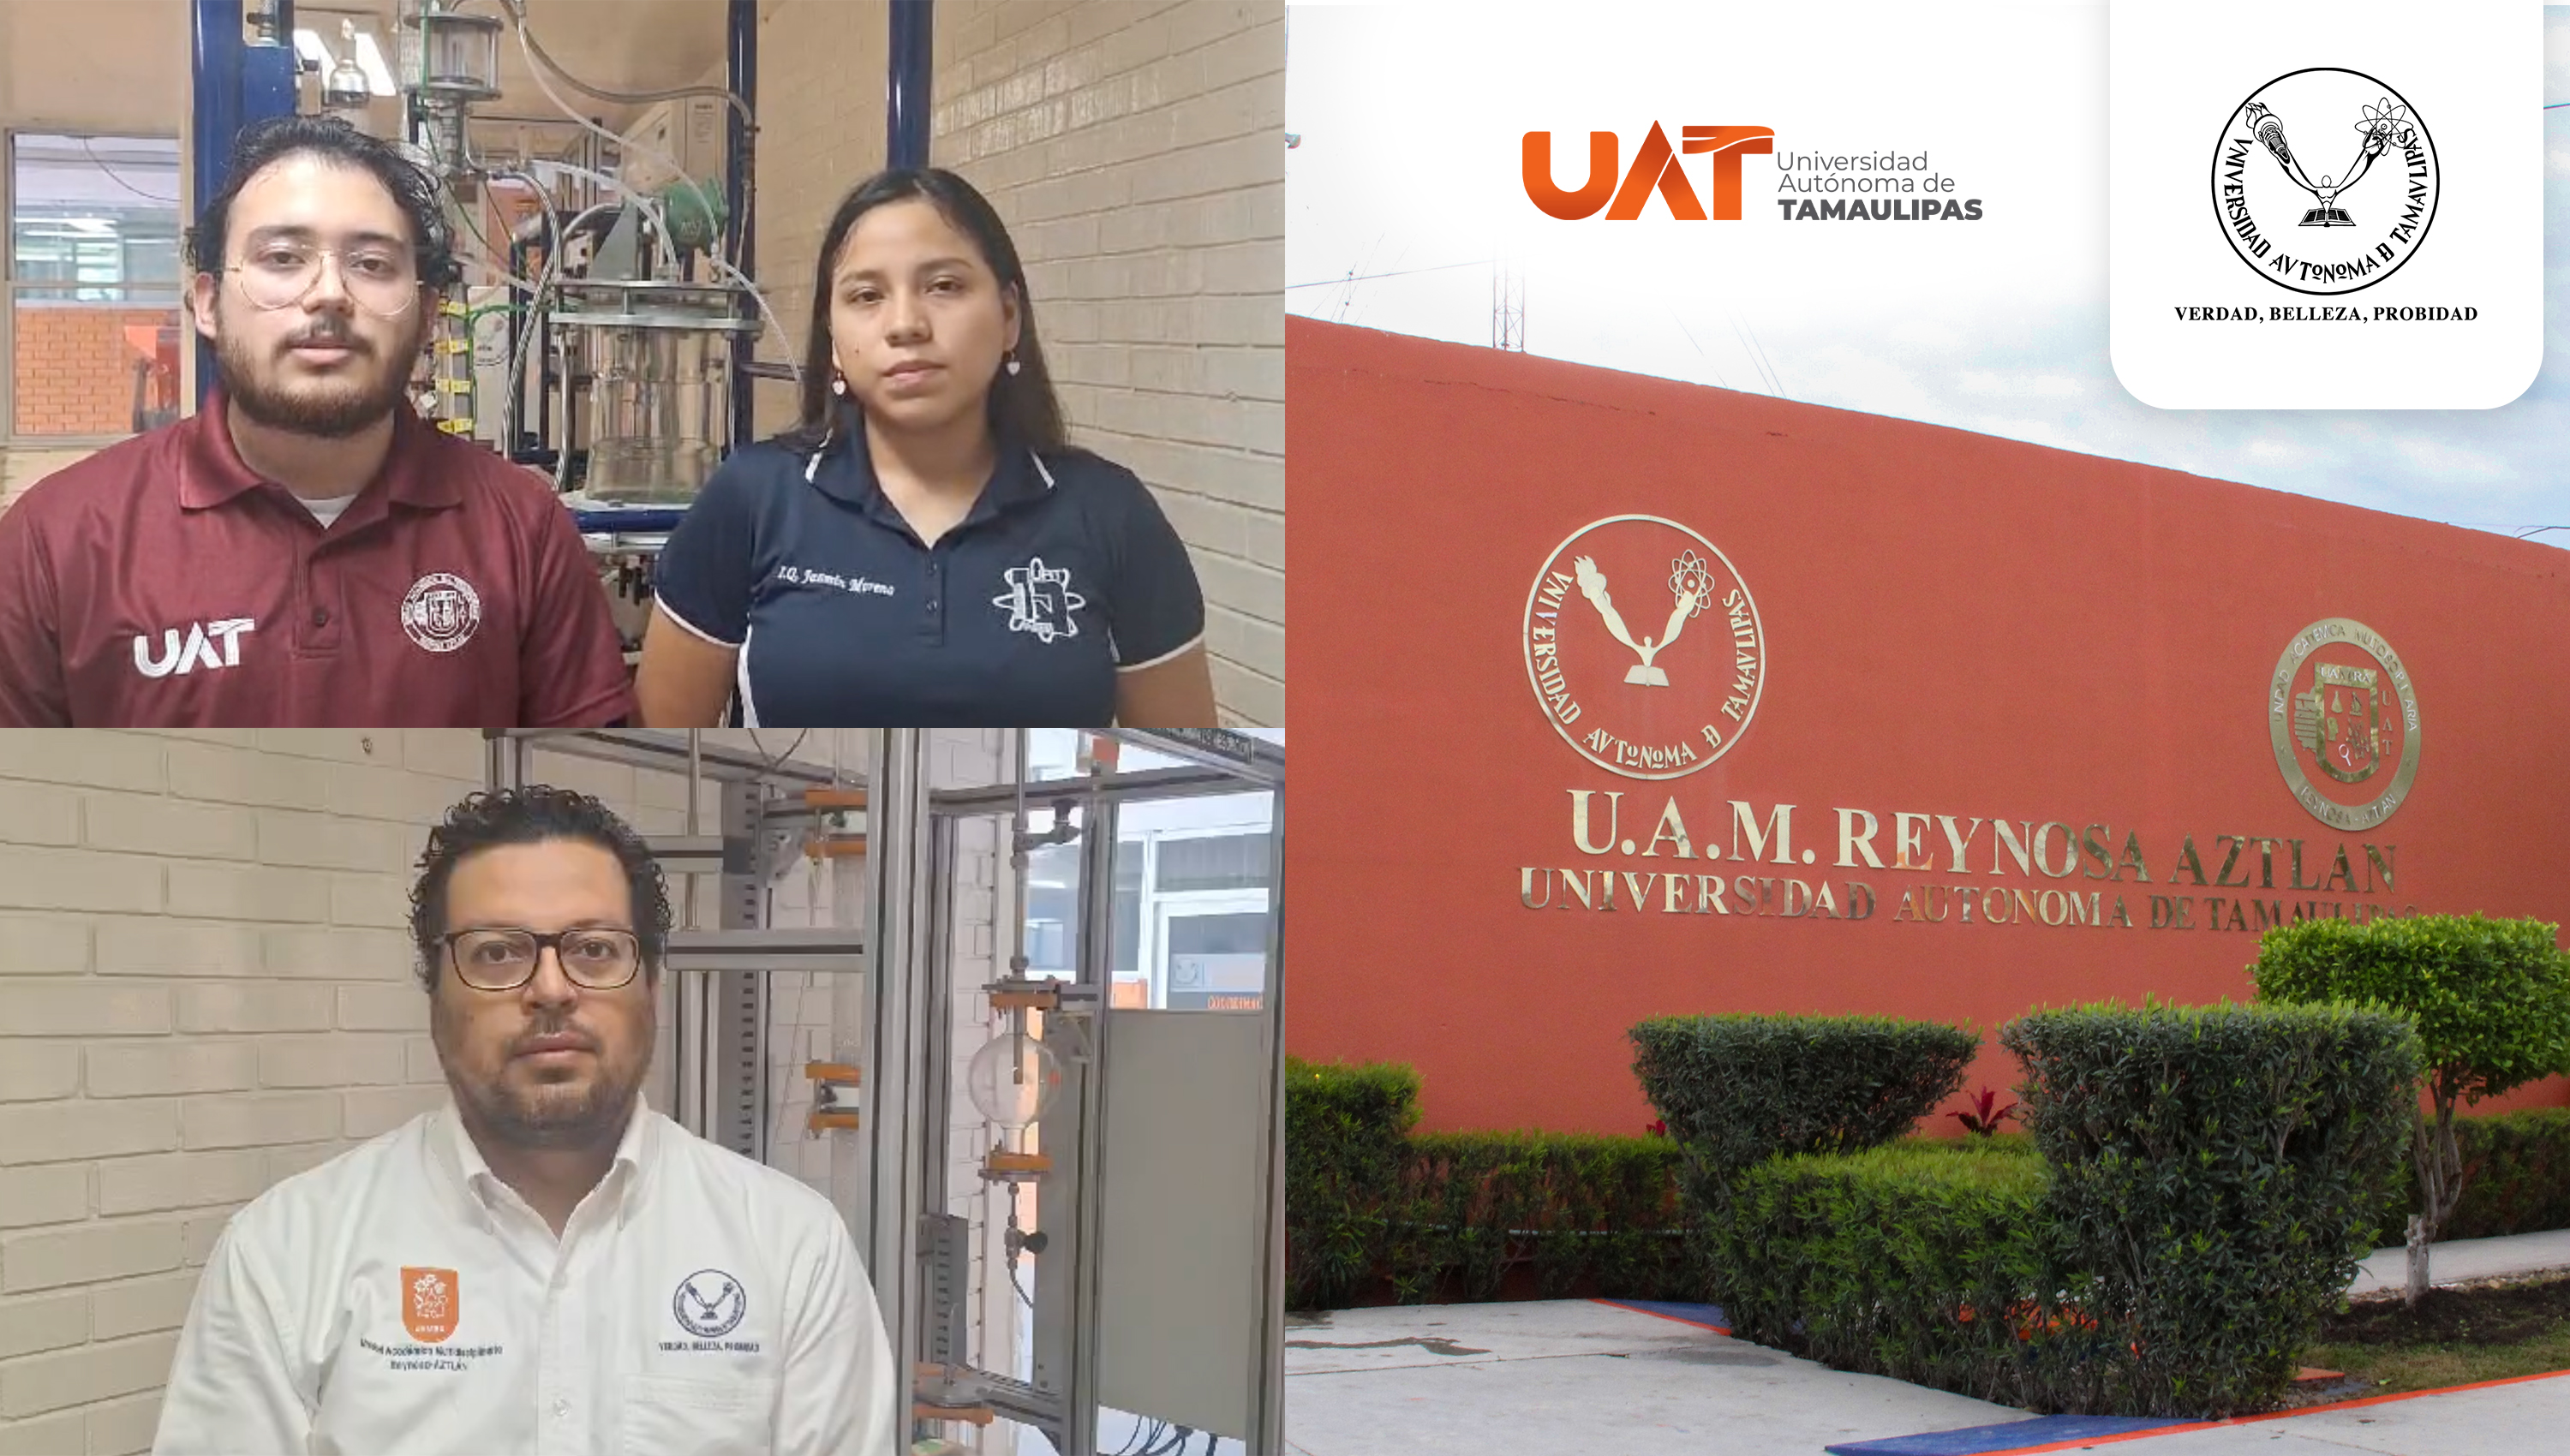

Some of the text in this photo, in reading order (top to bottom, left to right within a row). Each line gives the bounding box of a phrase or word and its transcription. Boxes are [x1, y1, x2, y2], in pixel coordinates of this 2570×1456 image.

[133, 618, 255, 678] UAT
[1567, 789, 2396, 894] U.A.M. REYNOSA AZTLAN
[1519, 867, 1877, 920] UNIVERSIDAD
[1894, 884, 2134, 928] AUTONOMA
[2149, 894, 2196, 929] DE
